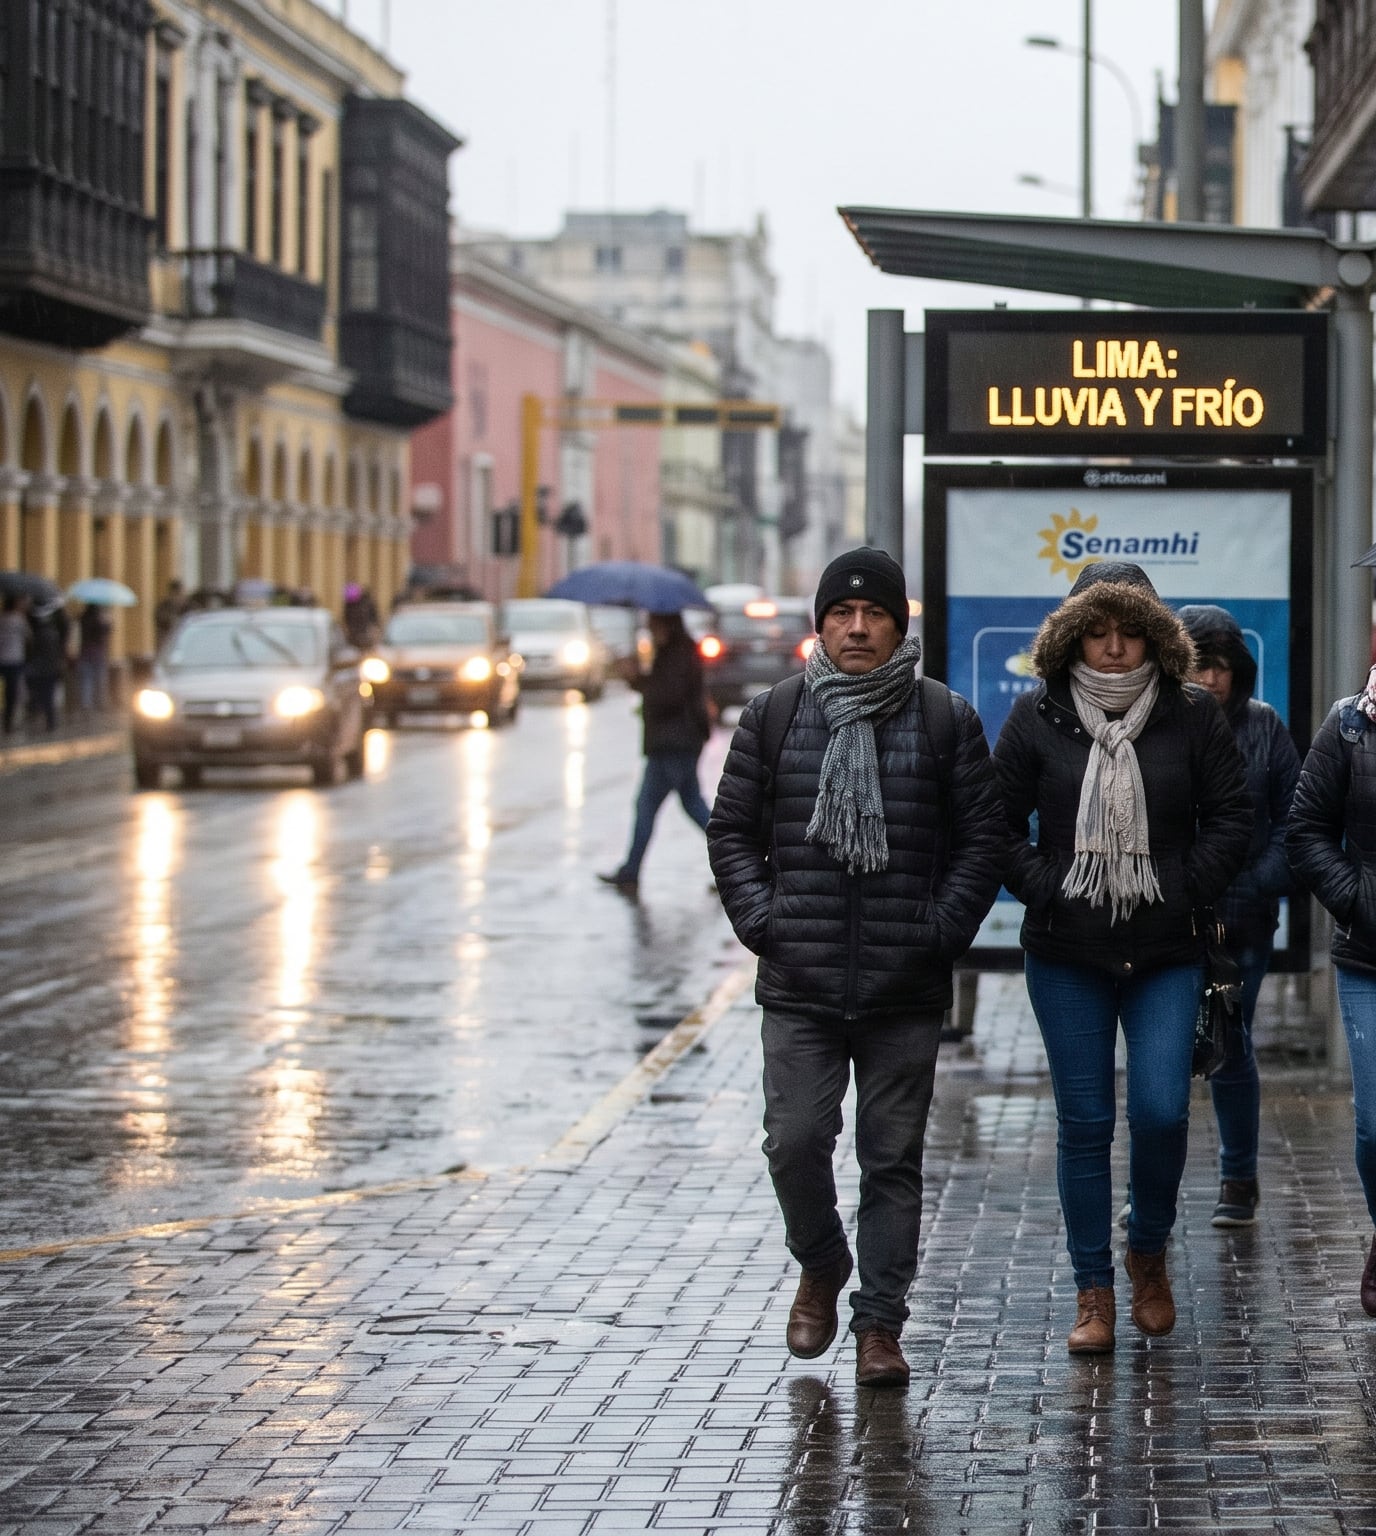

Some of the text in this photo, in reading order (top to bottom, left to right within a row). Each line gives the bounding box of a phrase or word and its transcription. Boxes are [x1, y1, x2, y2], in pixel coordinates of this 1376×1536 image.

[1073, 340, 1177, 378] LIMA:
[989, 379, 1264, 427] LLUVIA Y FRÍO
[1061, 531, 1199, 559] Senamhi
